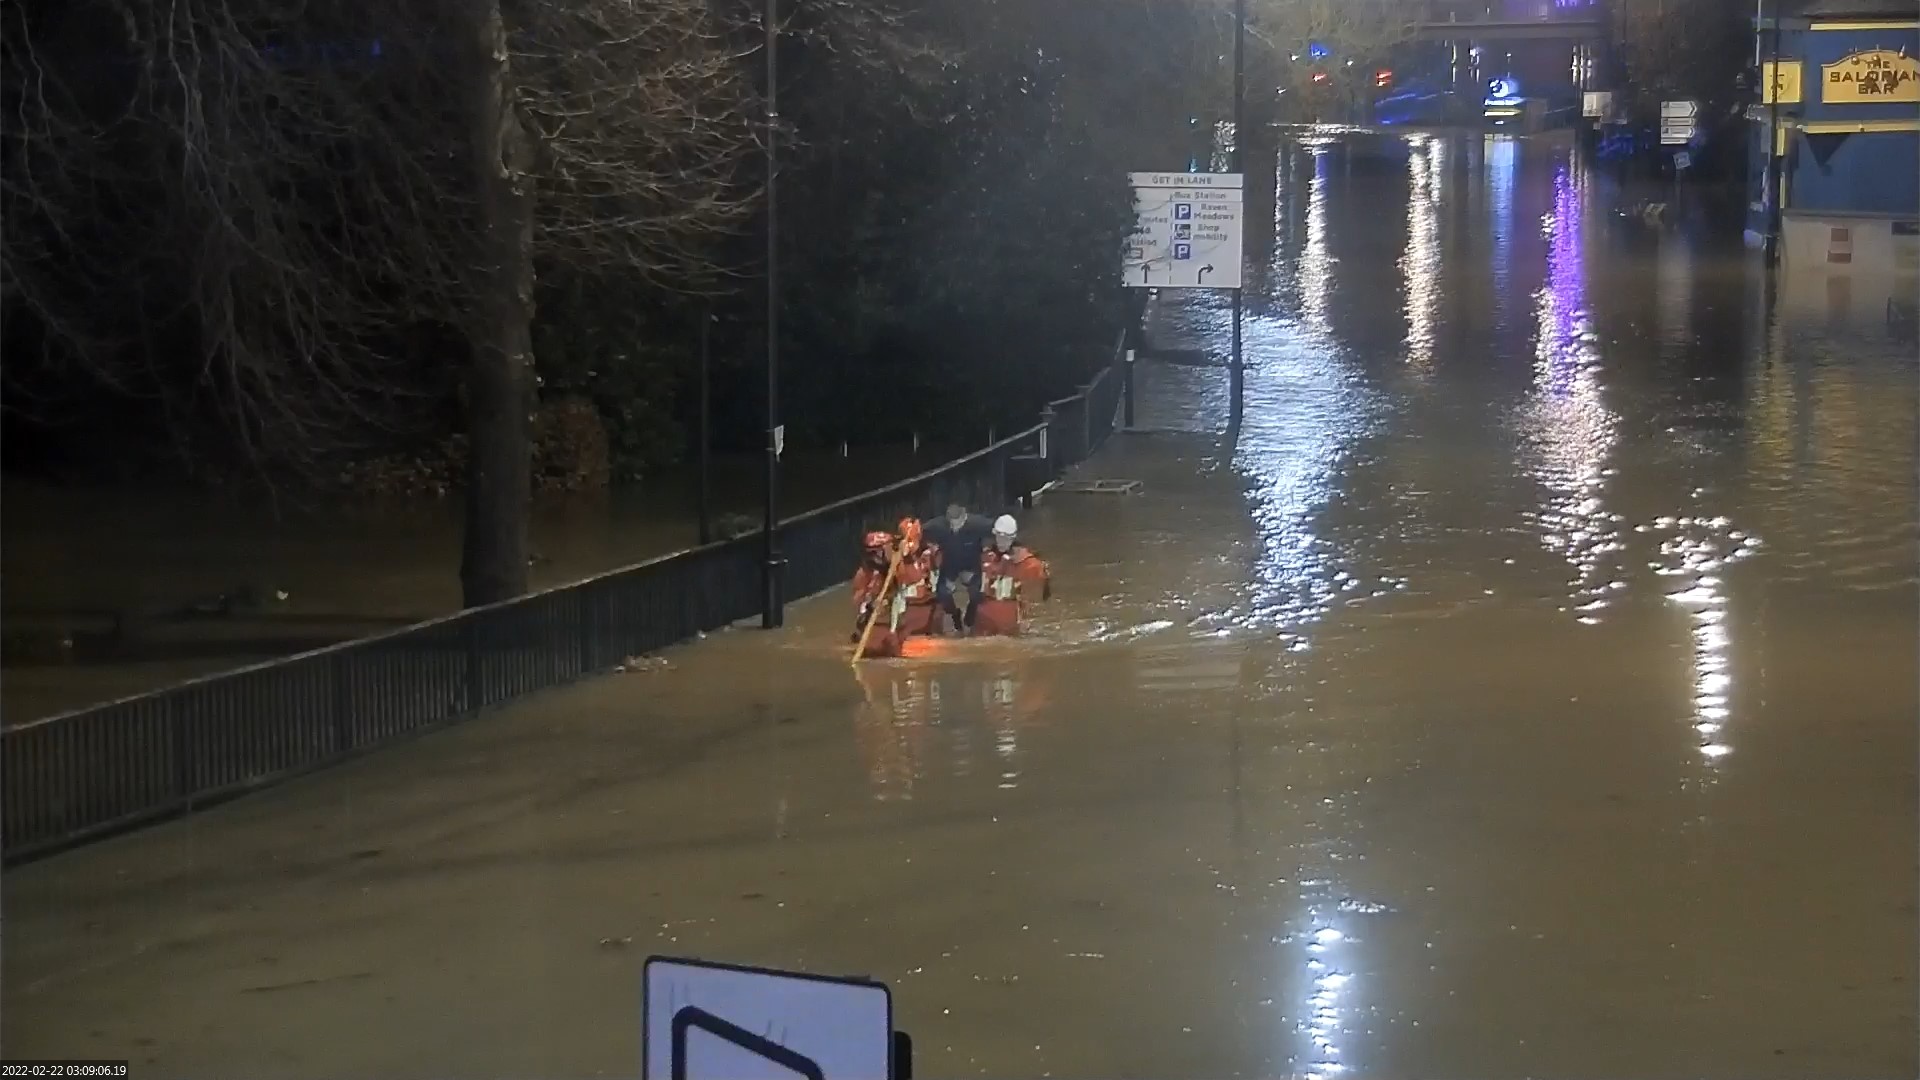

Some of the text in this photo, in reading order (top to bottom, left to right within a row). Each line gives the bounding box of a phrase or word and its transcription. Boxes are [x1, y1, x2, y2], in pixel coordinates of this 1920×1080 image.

[1858, 83, 1895, 94] BAR
[1152, 177, 1212, 185] GET IN LANE
[1195, 191, 1226, 200] Station
[1193, 212, 1234, 220] Meadows
[1197, 223, 1219, 232] Shop
